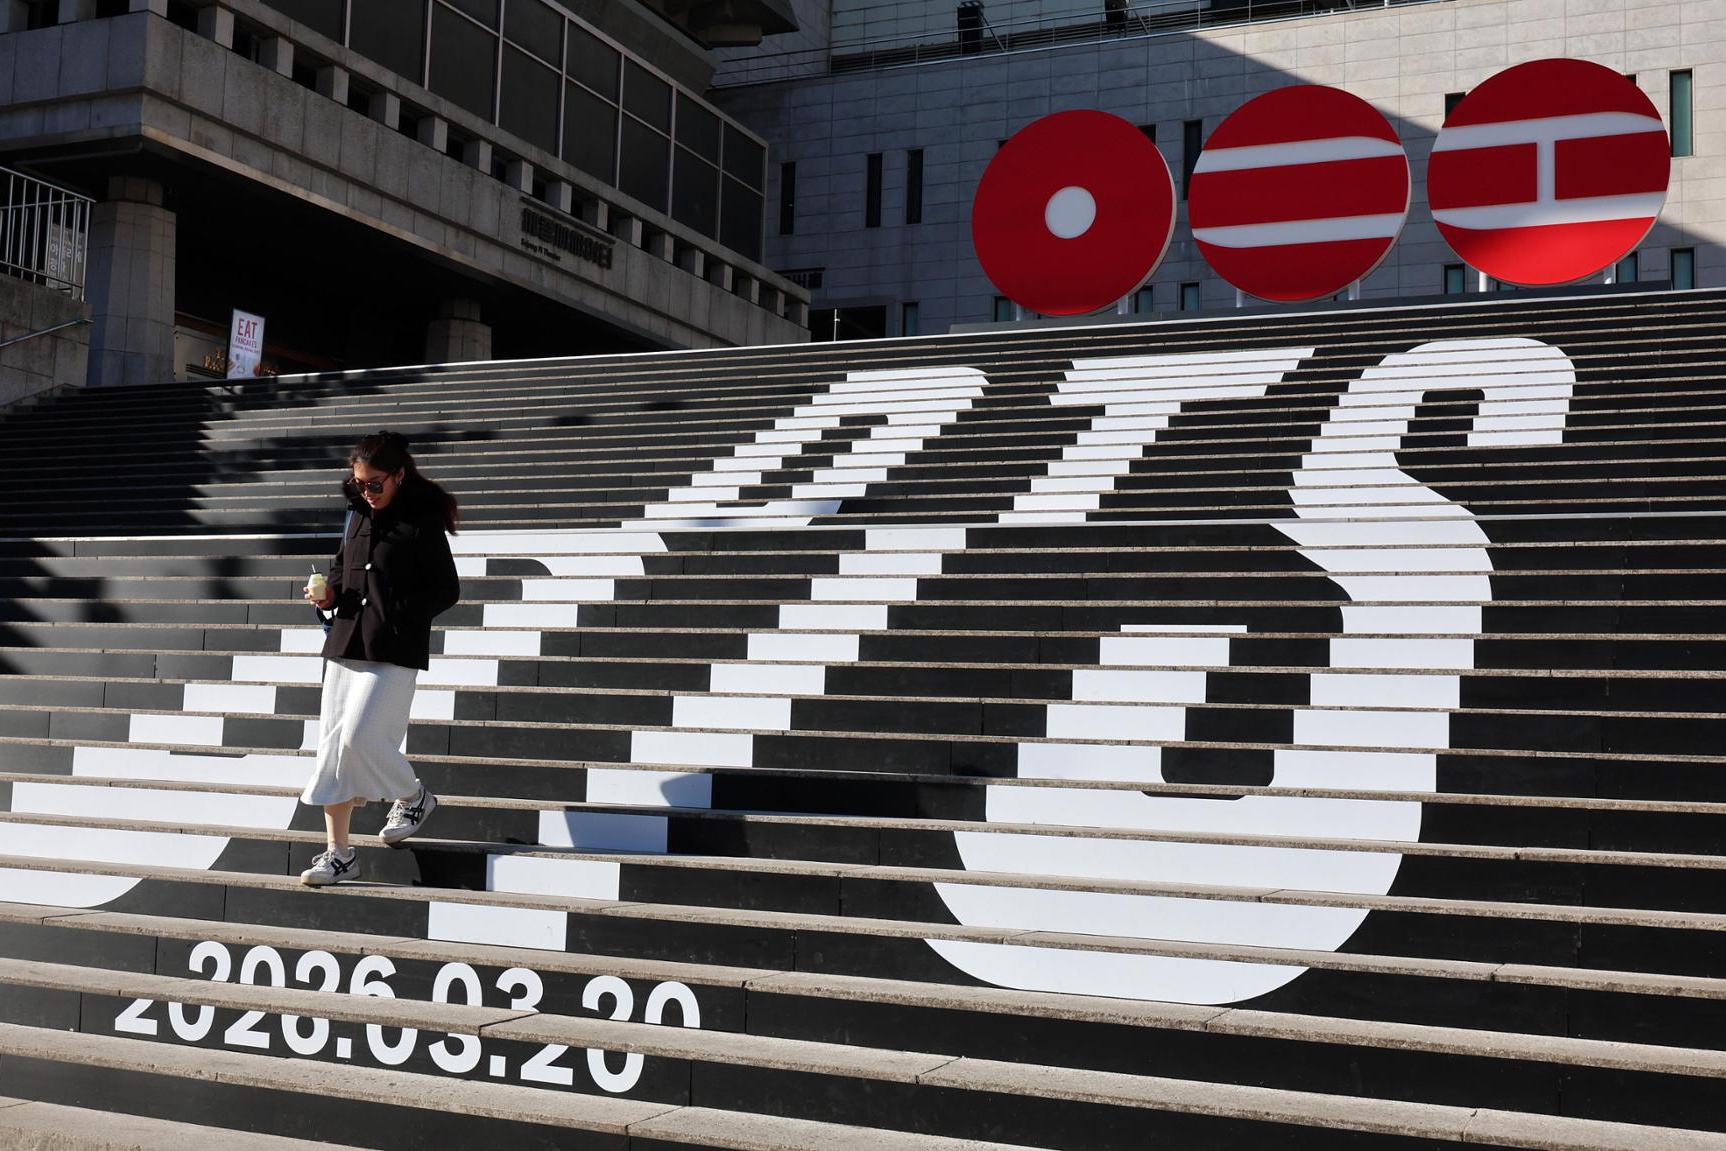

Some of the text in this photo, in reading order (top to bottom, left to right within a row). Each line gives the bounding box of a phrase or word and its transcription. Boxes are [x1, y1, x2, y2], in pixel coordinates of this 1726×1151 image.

[238, 317, 258, 340] EAT
[0, 336, 1577, 1005] BTS
[114, 940, 701, 1093] 2026.03.20
